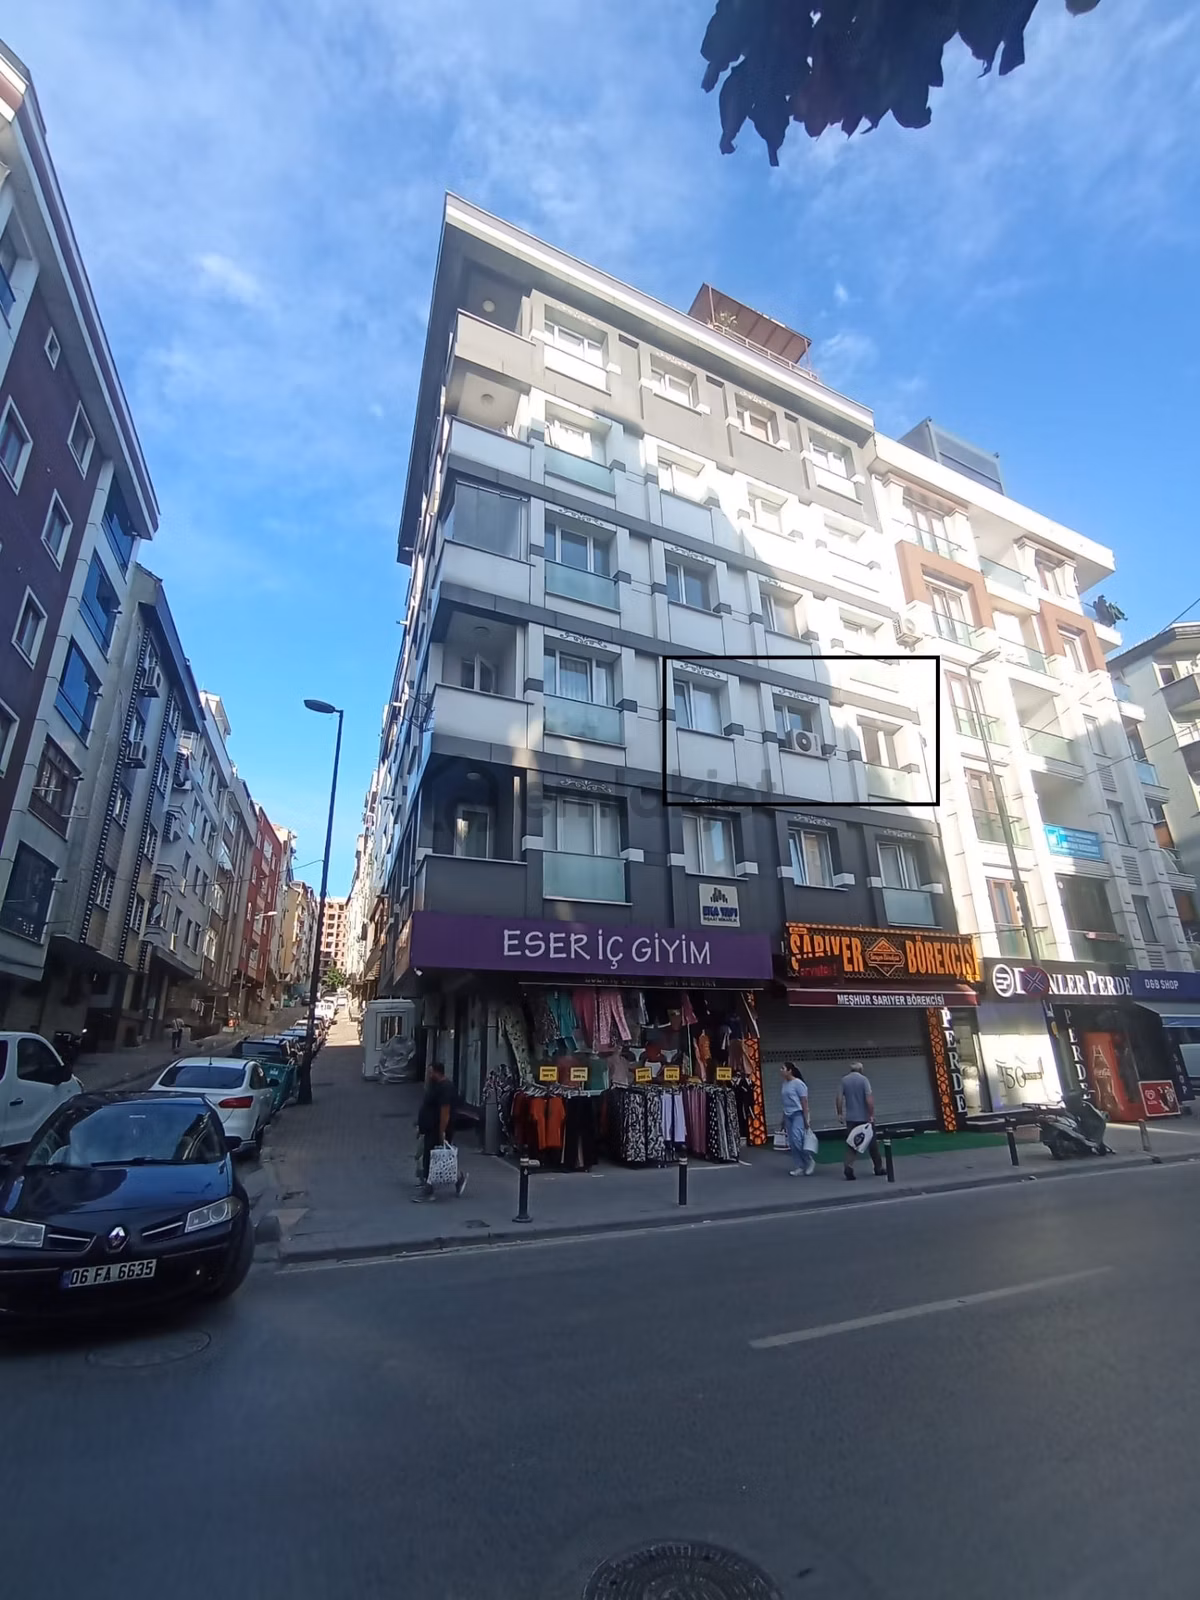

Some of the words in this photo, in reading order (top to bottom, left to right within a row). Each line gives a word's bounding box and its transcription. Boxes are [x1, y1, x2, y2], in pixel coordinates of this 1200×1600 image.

[503, 929, 590, 960] ESER
[598, 929, 623, 969] İÇ
[632, 932, 710, 965] GİYİM
[1085, 970, 1133, 996] PERDE
[1160, 980, 1179, 990] SHOP
[837, 994, 871, 1006] MEŞHUR
[872, 995, 906, 1006] SARIYER
[941, 1007, 968, 1113] PERDE
[70, 1270, 89, 1285] 06
[94, 1266, 111, 1282] FA
[118, 1261, 154, 1279] 6635
